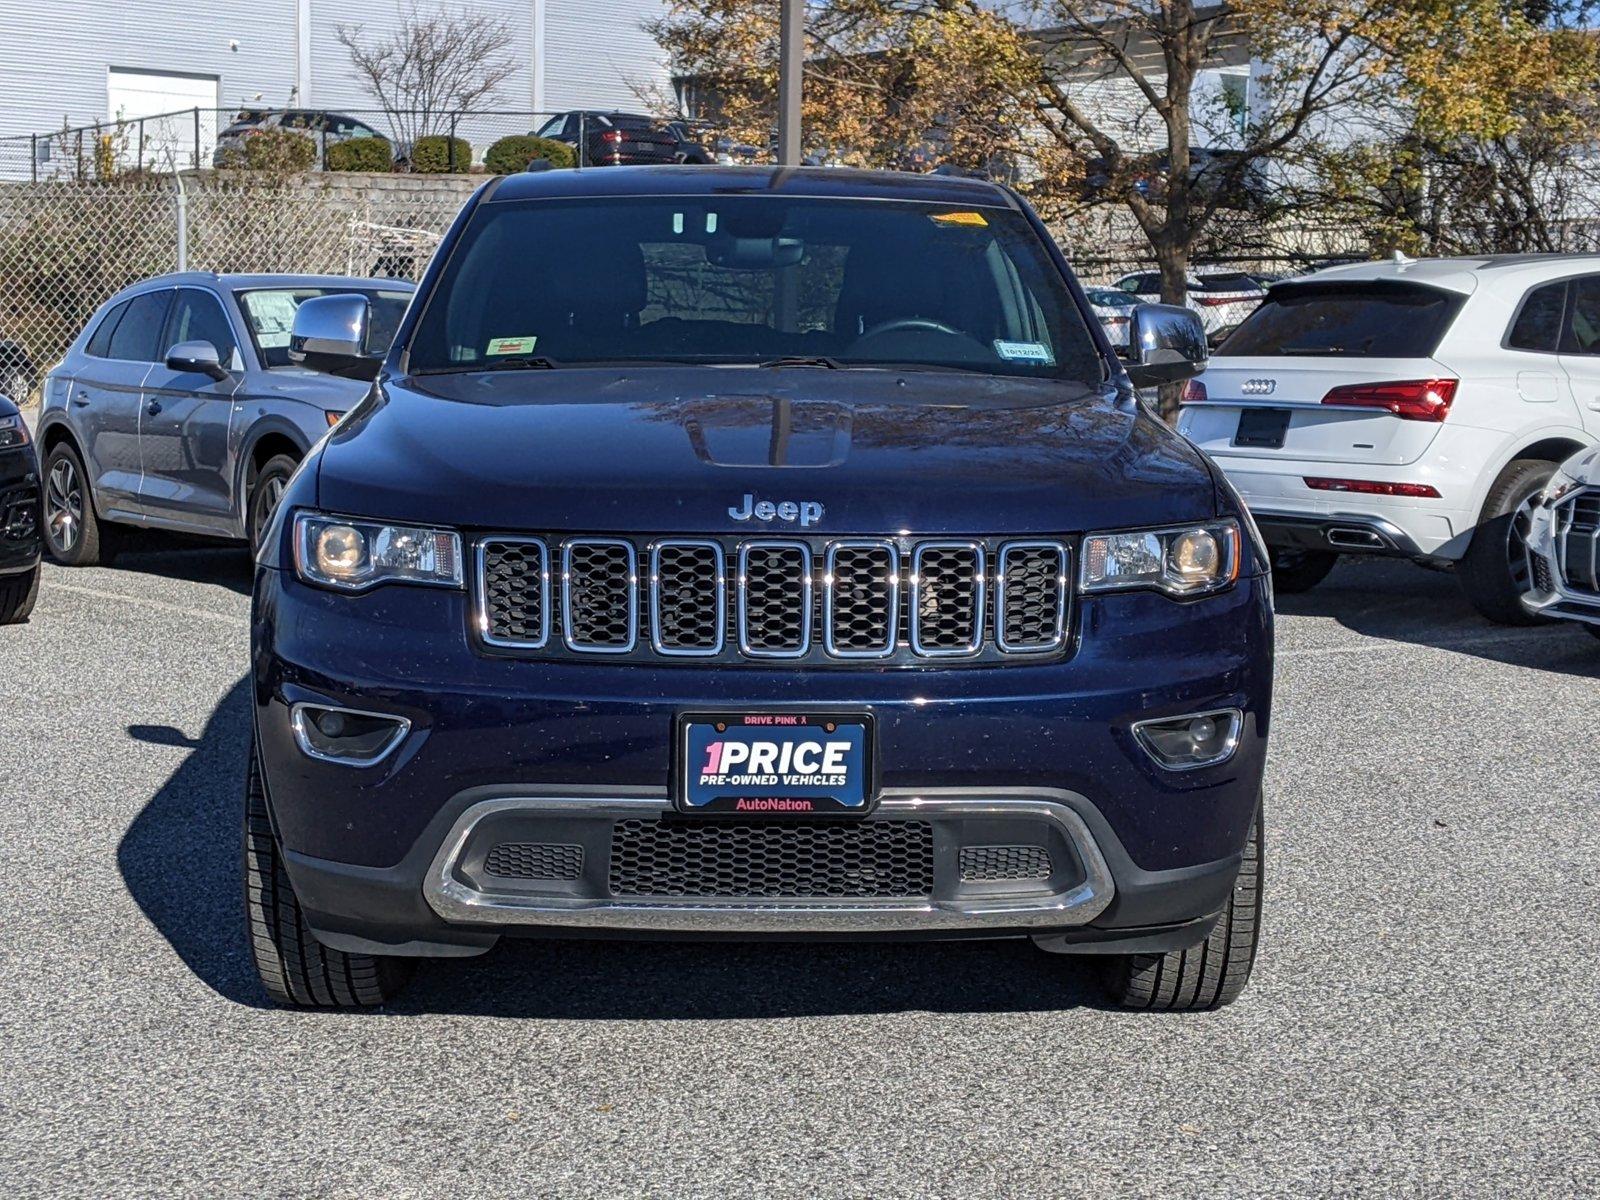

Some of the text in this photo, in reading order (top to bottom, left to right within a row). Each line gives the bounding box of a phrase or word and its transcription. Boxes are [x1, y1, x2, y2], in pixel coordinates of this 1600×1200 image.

[728, 494, 822, 526] Jeep
[744, 716, 797, 725] DRIVE PINK
[700, 775, 846, 785] PRE-OWNED VEHICLES
